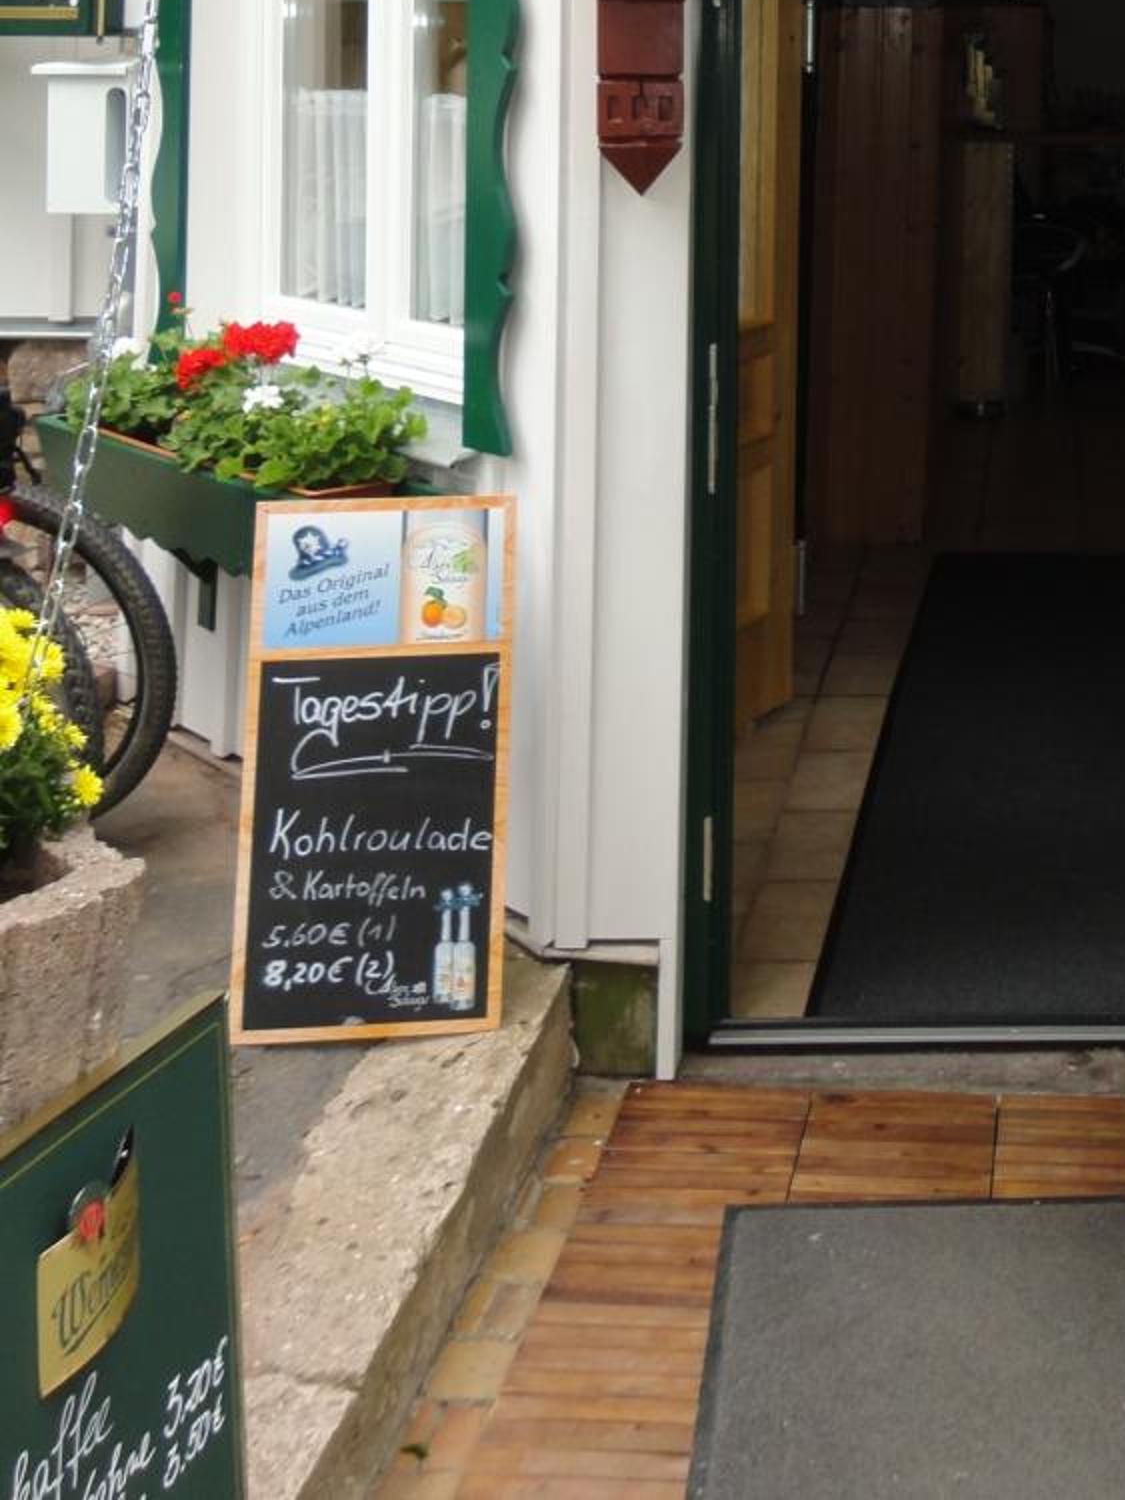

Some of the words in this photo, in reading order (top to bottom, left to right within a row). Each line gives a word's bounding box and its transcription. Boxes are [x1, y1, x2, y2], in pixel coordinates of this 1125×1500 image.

[278, 587, 312, 605] Das
[317, 564, 390, 593] Original
[296, 599, 328, 617] aus
[332, 588, 369, 610] dem
[272, 663, 501, 772] Tagestipp!
[269, 808, 493, 860] Kohlroulade
[268, 870, 297, 900] &
[303, 869, 426, 908] Kartoffeln
